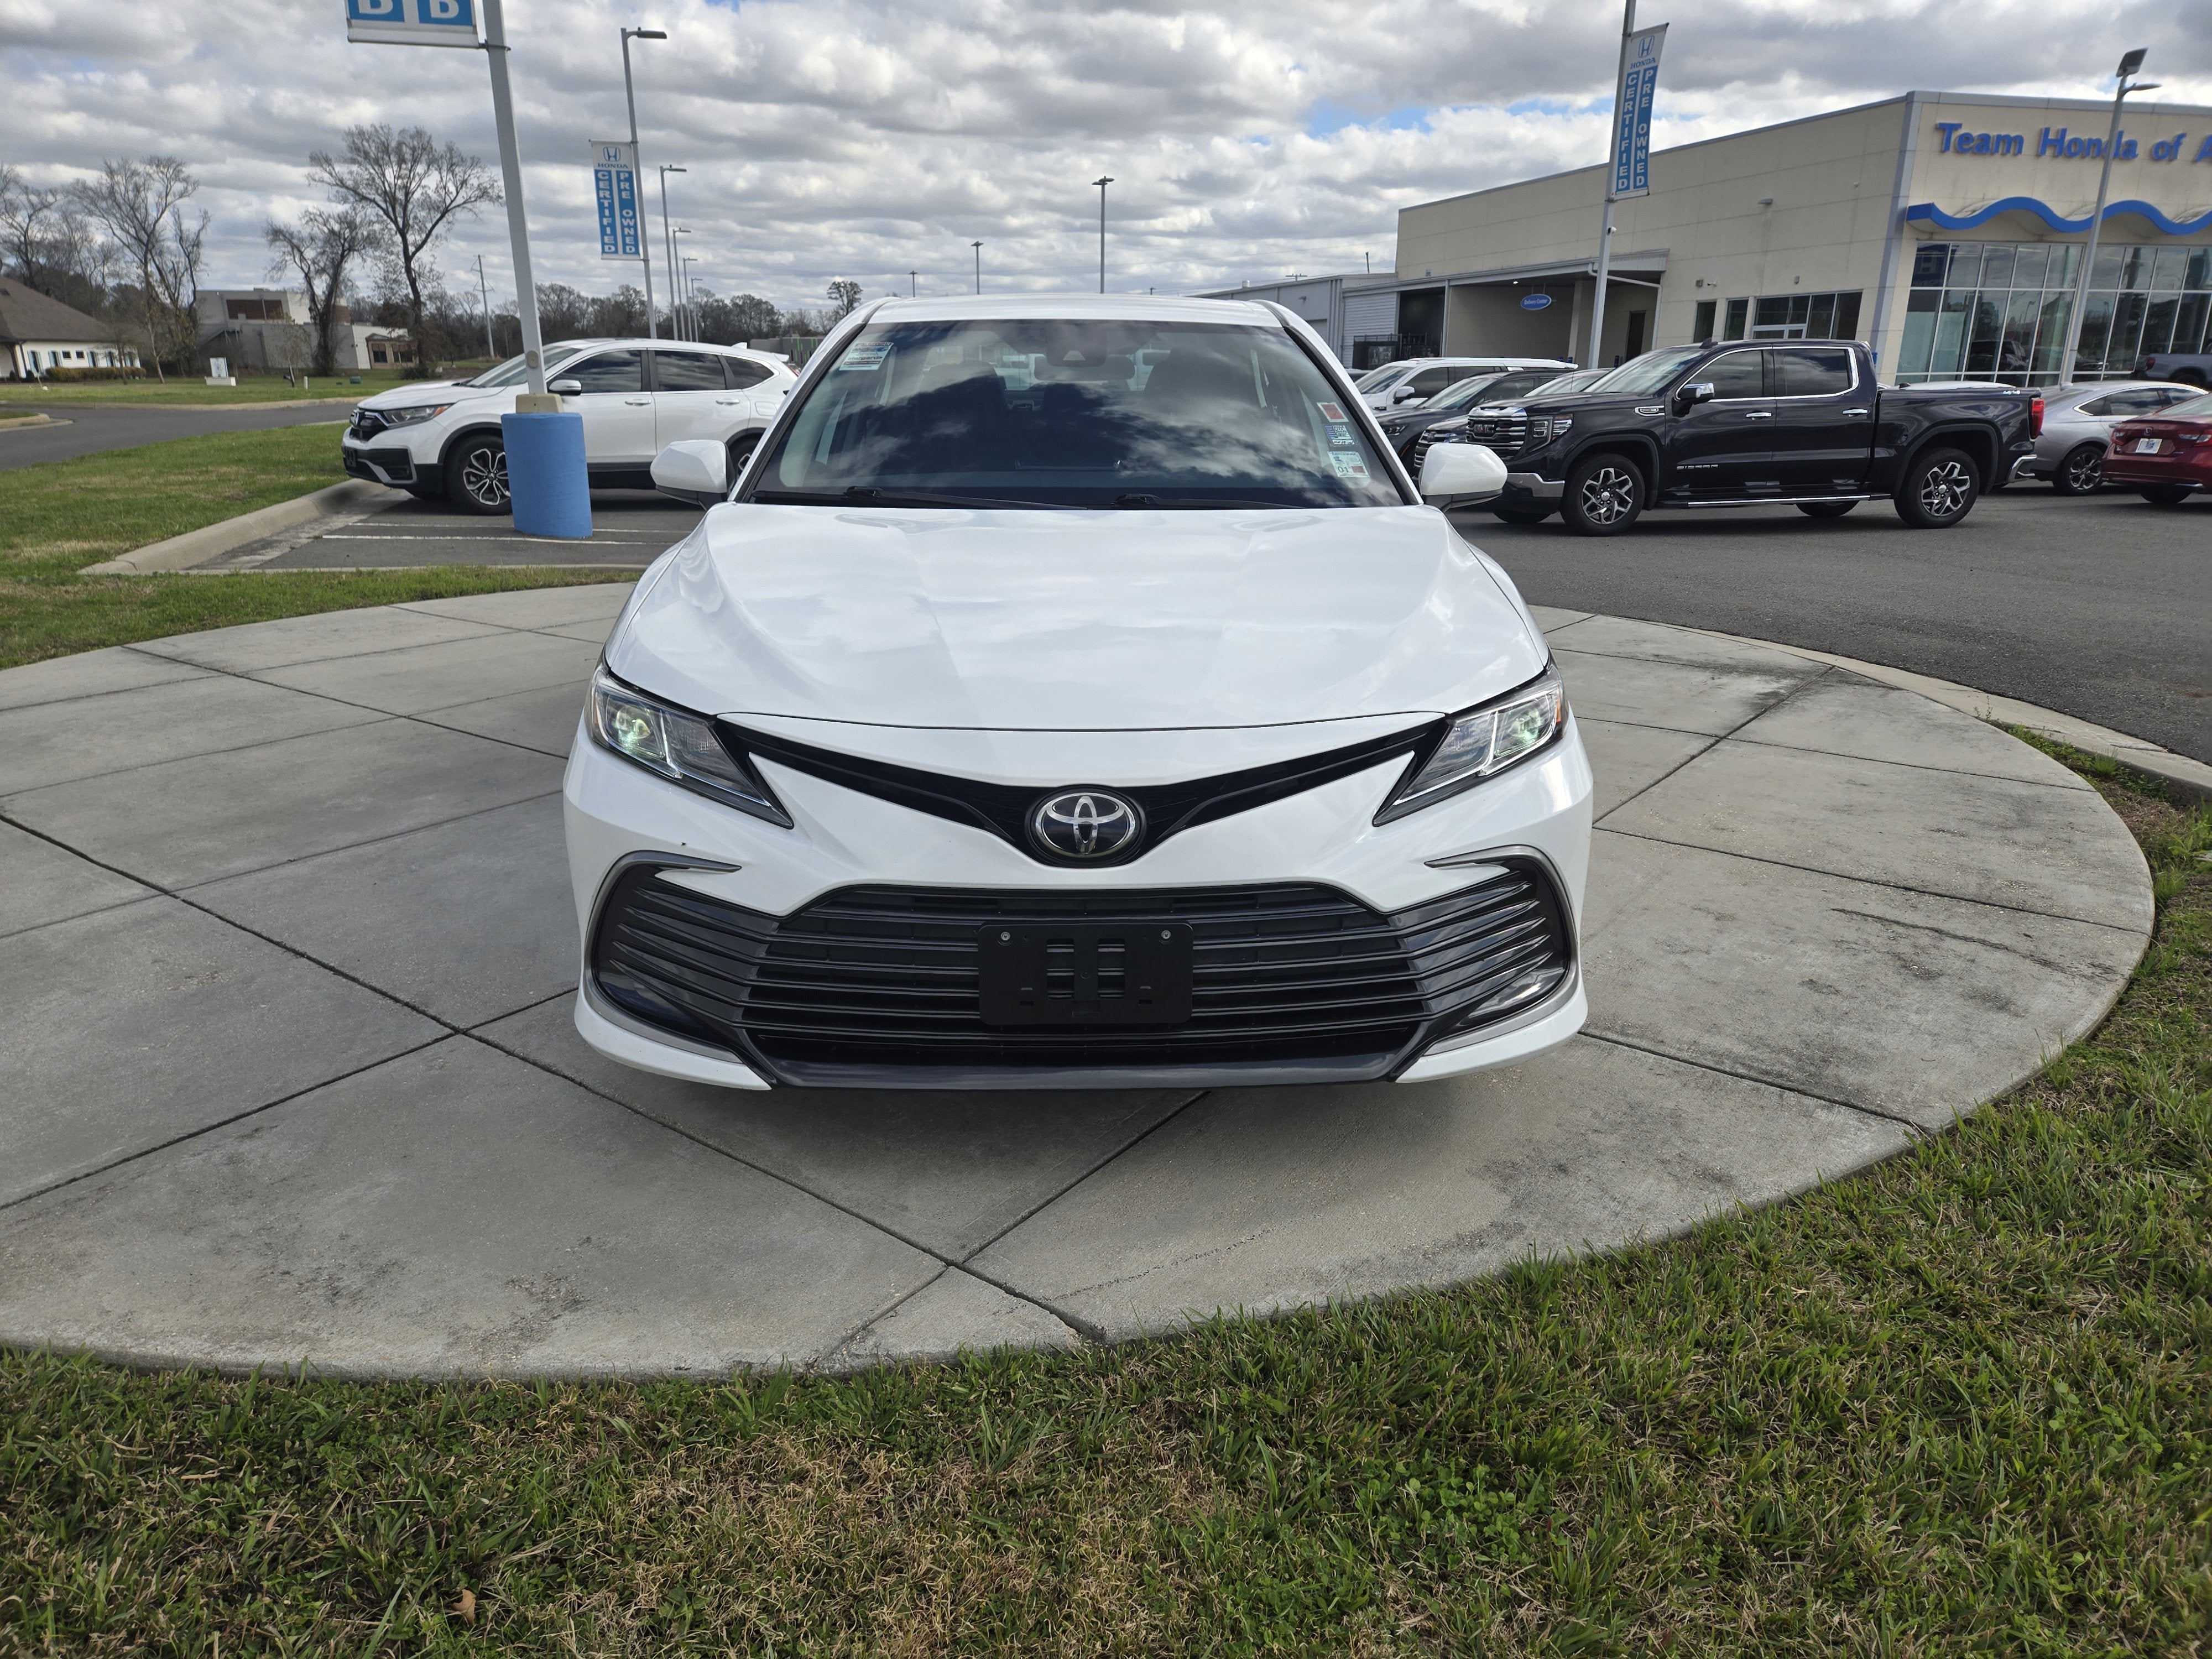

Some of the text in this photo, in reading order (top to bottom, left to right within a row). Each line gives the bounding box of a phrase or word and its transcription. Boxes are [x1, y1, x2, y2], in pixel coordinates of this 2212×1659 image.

[1630, 58, 1656, 70] HONDA
[1618, 74, 1637, 190] CERTIFIED
[1635, 69, 1654, 186] PRE OWNED
[1937, 122, 2025, 155] Team
[2152, 132, 2188, 161] of
[597, 171, 615, 253] CERTIFIED
[619, 171, 636, 254] PRE OWNED
[1474, 424, 1495, 434] GMC
